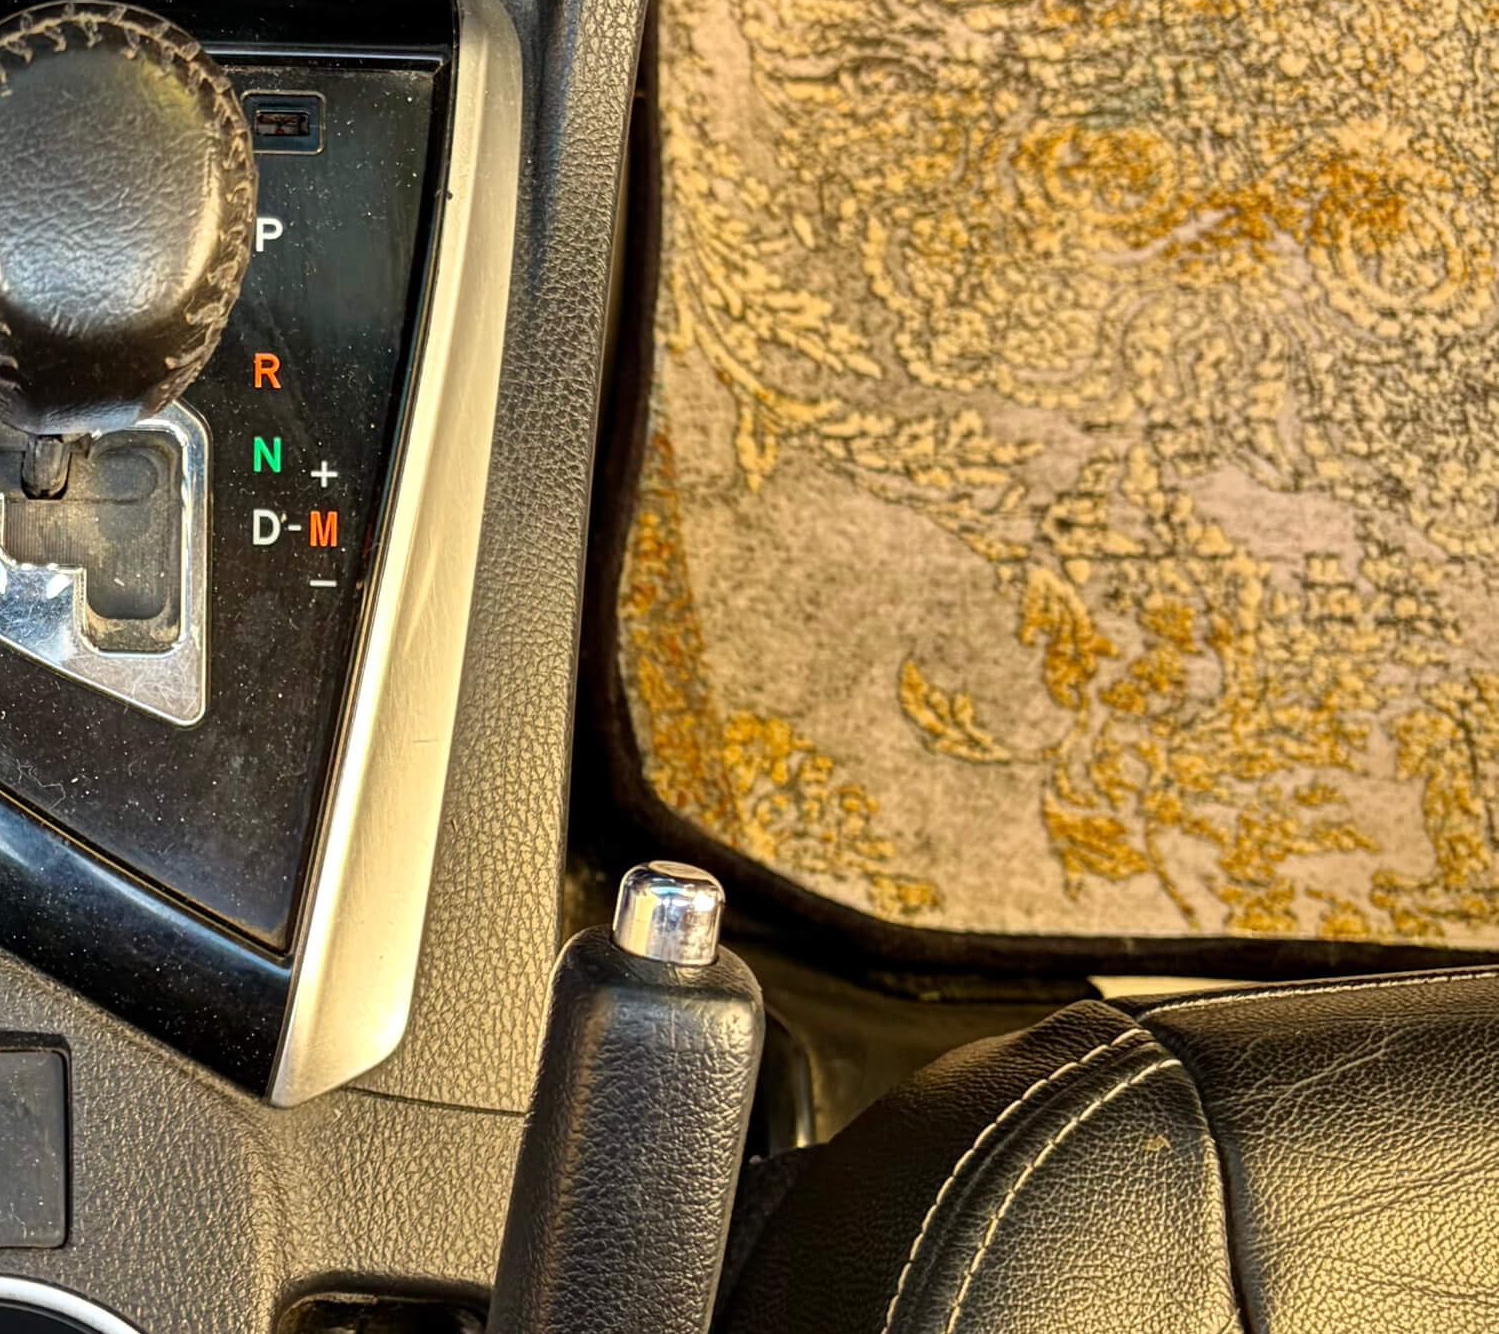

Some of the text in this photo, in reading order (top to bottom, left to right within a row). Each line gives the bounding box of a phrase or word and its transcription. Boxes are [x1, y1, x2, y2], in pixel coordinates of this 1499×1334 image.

[255, 216, 284, 253] P
[253, 352, 282, 389] R
[253, 436, 282, 473] N
